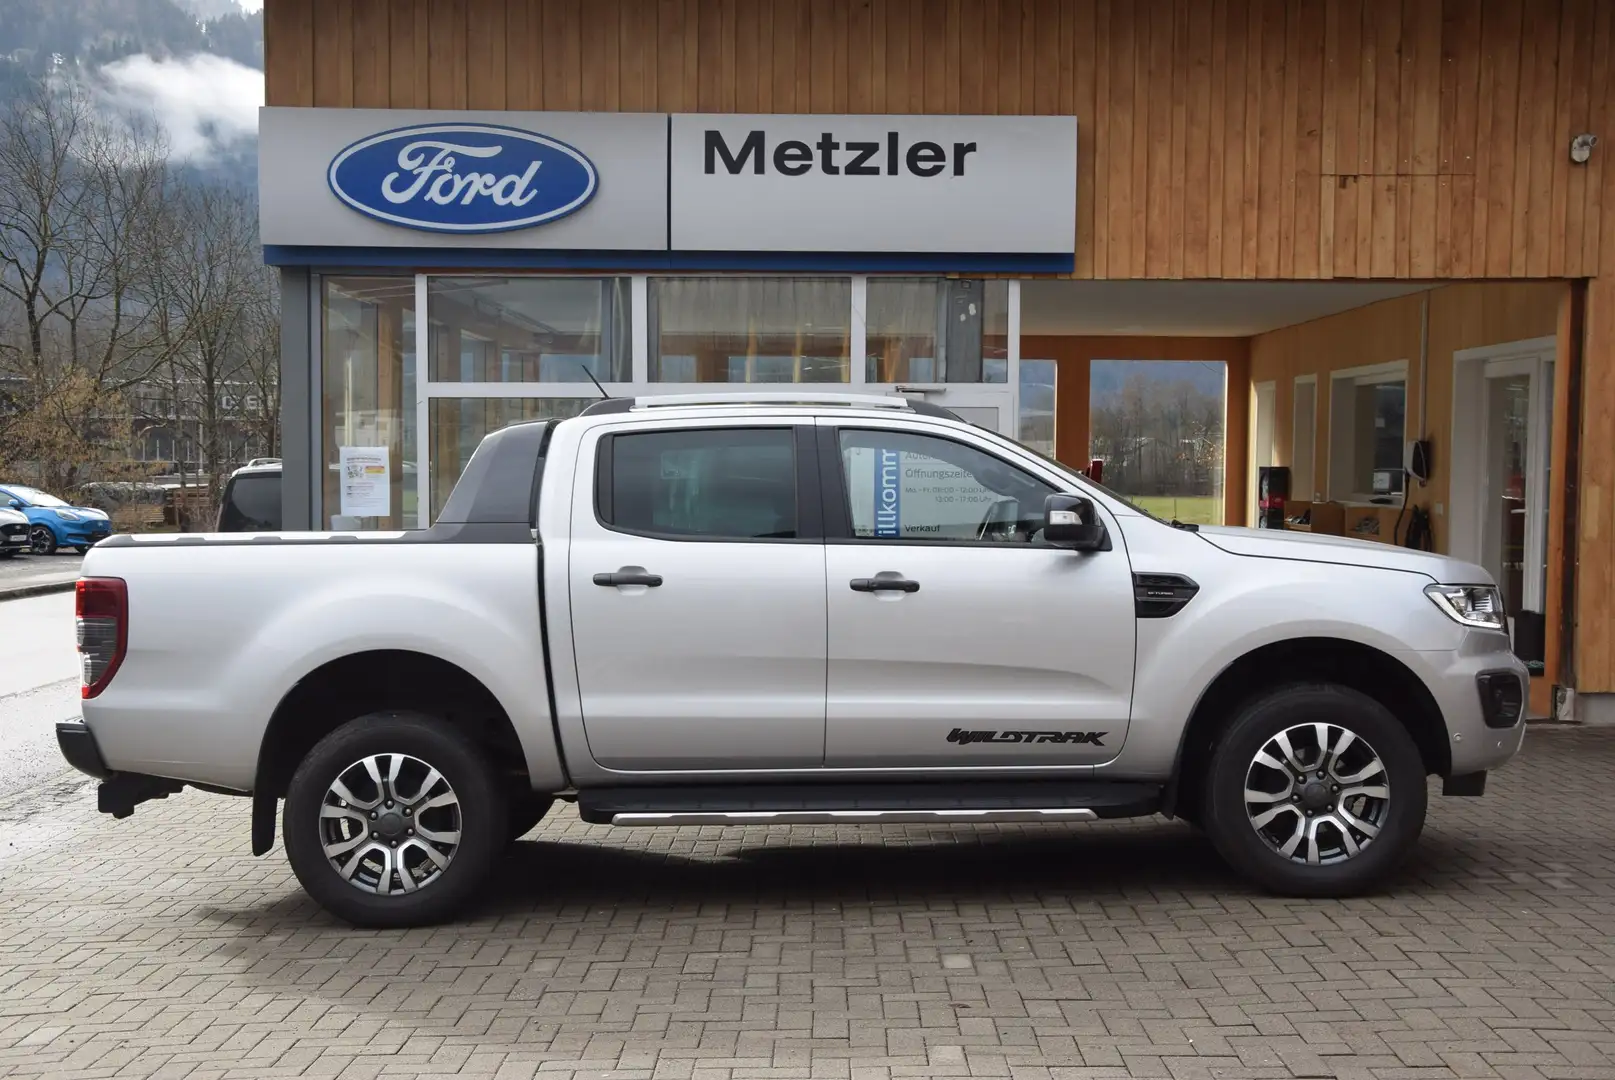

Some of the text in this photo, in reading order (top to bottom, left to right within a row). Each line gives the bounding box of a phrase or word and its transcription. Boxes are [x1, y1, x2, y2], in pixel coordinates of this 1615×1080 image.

[381, 140, 543, 208] Ford
[704, 129, 977, 178] Metzler
[877, 449, 897, 535] illkomm
[905, 468, 973, 480] Öffnungszeite
[946, 727, 1109, 747] WILDTRAK
